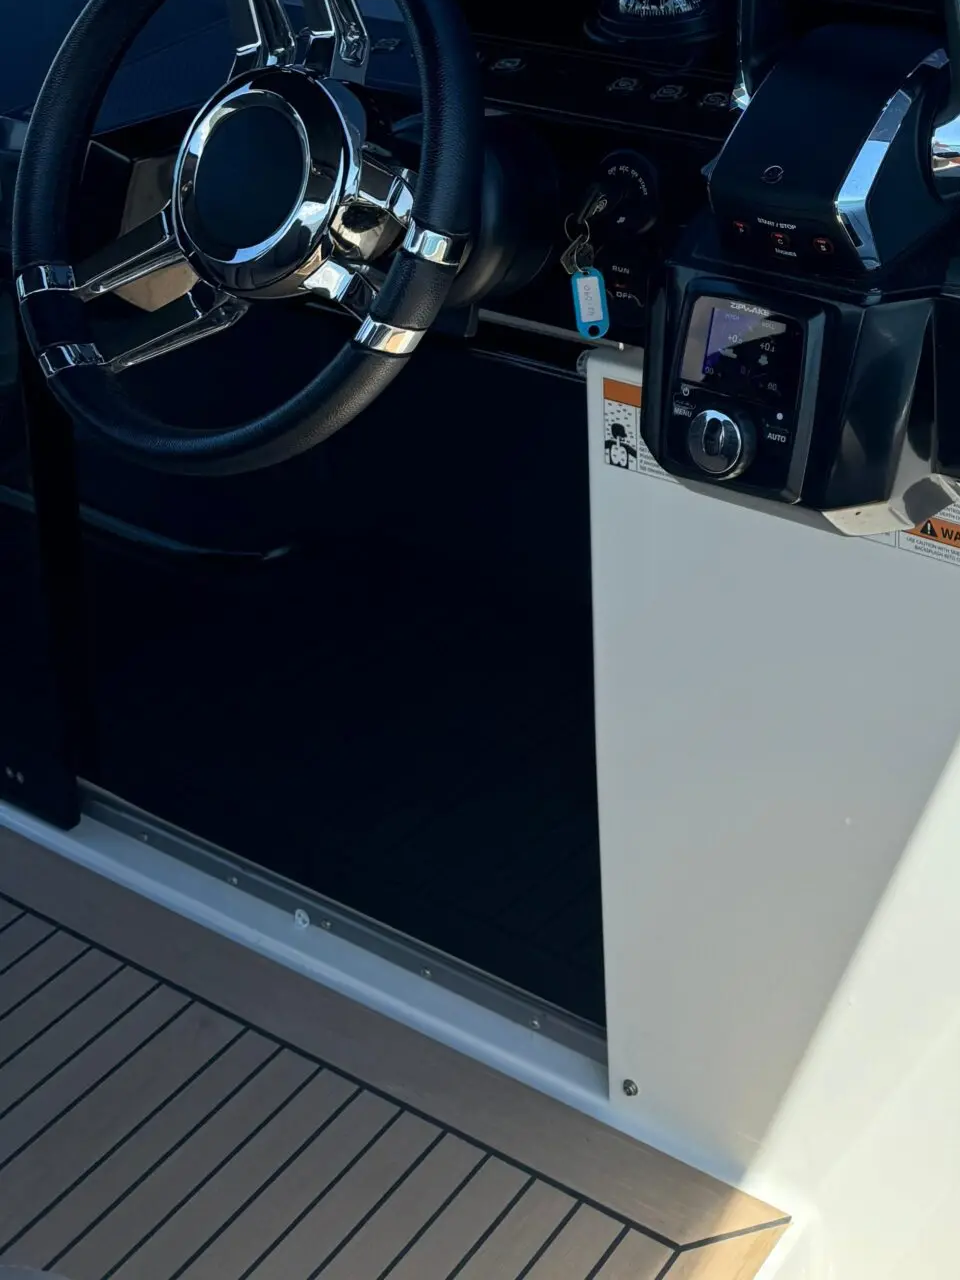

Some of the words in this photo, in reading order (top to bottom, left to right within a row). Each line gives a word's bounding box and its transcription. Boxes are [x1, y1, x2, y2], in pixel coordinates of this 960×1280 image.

[612, 264, 630, 275] RUN
[674, 407, 692, 417] MENU
[767, 432, 786, 443] AUTO
